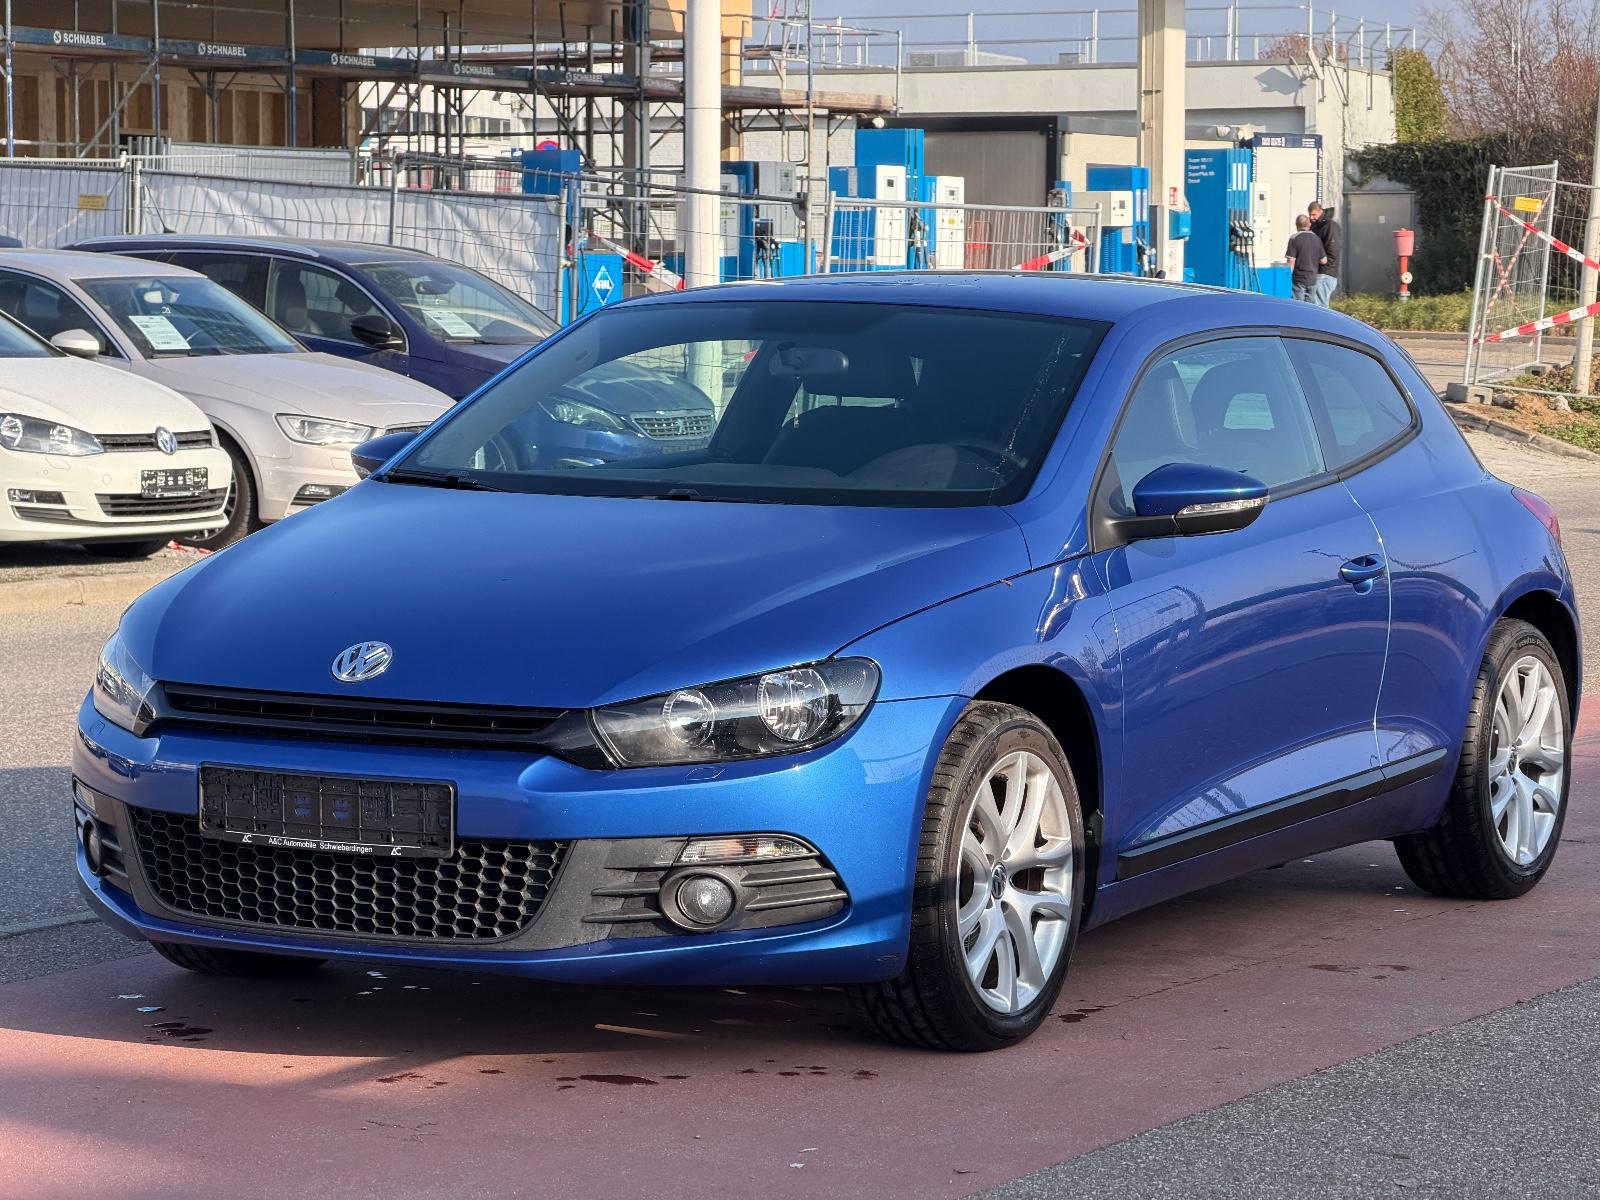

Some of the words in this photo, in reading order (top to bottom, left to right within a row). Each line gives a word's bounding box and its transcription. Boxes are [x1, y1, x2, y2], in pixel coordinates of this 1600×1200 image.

[63, 32, 107, 46] SCHNABEL
[207, 44, 247, 57] SCHNABEL
[339, 54, 376, 67] SCHNABEL
[461, 65, 496, 76] SCHNABEL
[573, 73, 605, 83] SCHNABEL
[595, 279, 611, 289] ARAL
[268, 837, 283, 846] A&C
[283, 838, 317, 849] Automobile
[319, 841, 373, 854] Schwieberdingen
